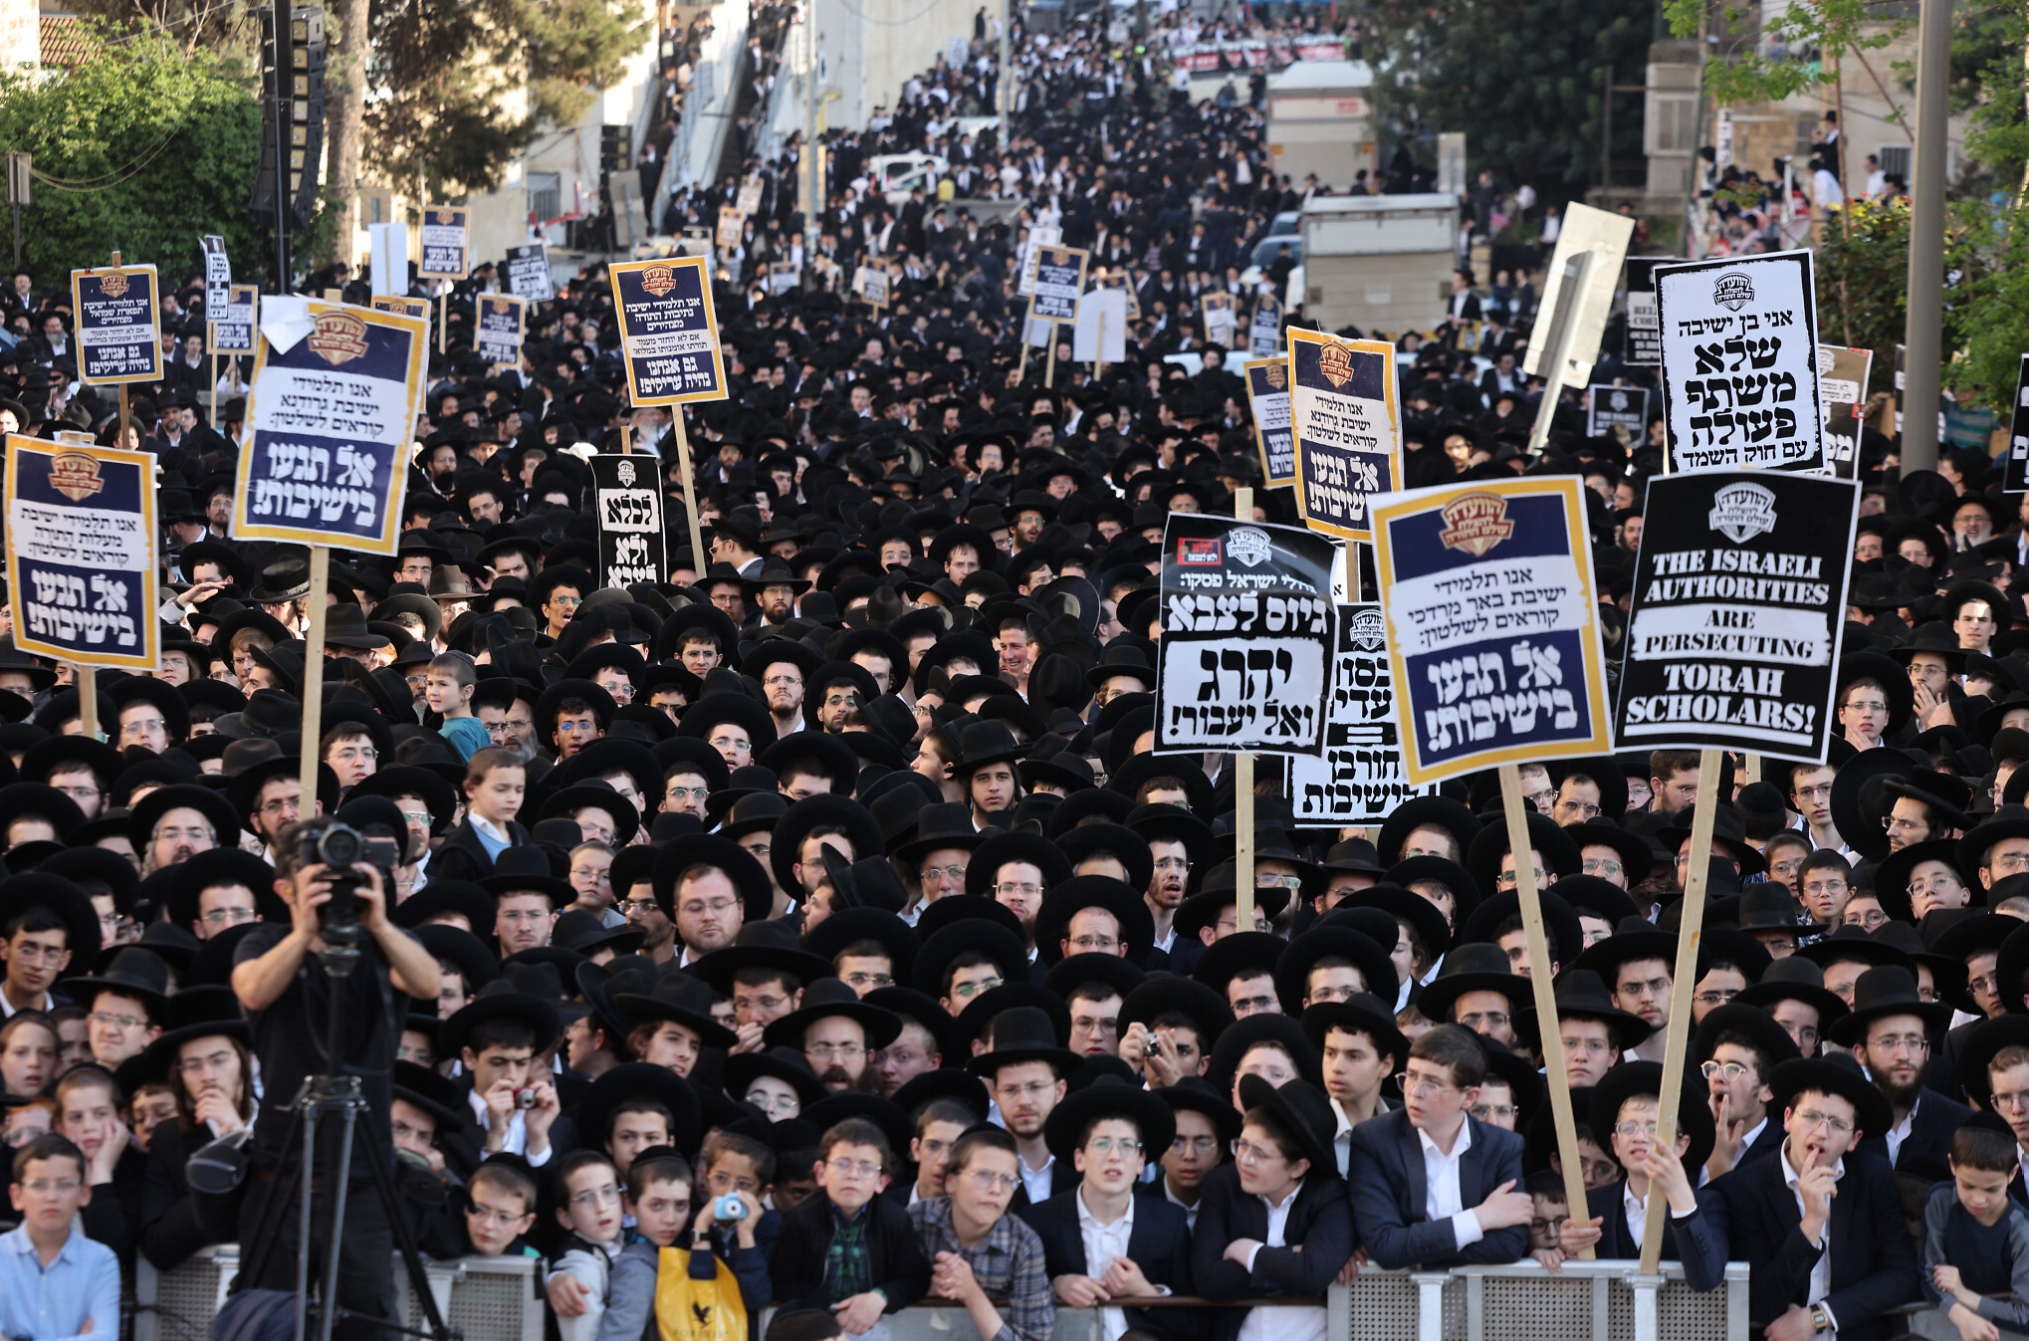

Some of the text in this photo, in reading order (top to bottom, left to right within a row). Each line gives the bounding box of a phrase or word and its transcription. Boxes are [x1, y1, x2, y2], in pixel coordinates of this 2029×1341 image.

[84, 298, 148, 310] אנו תלמידי ישיבת
[89, 307, 143, 317] תפארת שמואל
[626, 297, 700, 313] אנו תלמידי ישיבת
[635, 308, 694, 322] נתיבות התורה
[101, 316, 132, 325] מצהירים
[647, 320, 684, 331] מצהירים
[1678, 317, 1733, 337] ישיבה
[1739, 315, 1759, 336] בן
[1764, 310, 1792, 327] אני
[658, 335, 675, 344] יוחזר
[658, 344, 685, 352] אומנותו
[678, 333, 687, 341] לא
[90, 358, 150, 374] נהיה עריקים!
[98, 346, 140, 360] גם אנחנו
[647, 356, 698, 376] גם אנחנו
[1694, 335, 1781, 375] שלא
[293, 375, 372, 398] אנו תלמידי
[640, 372, 711, 394] נהיה עריקים!
[1685, 371, 1796, 414] משתף
[281, 394, 380, 416] ישיבת גרודנא
[1315, 395, 1363, 416] אנו תלמידי
[271, 412, 384, 440] קוראים לשלטון:
[1311, 410, 1338, 427] גרודנא
[1341, 416, 1370, 431] ישיבת
[1690, 407, 1797, 447] פעולה
[1307, 424, 1378, 450] קוראים לשלטון:
[268, 442, 376, 489] אל תגעו
[1683, 441, 1808, 468] עם חוק השמד
[1310, 450, 1347, 487] תגעו
[1350, 456, 1380, 492] אל
[252, 479, 376, 528] בישיבות!
[607, 494, 652, 526] לכלא
[1308, 480, 1368, 521] שיבות!
[1446, 498, 1502, 522] הוועדה
[1721, 490, 1768, 506] הוועדה
[20, 507, 136, 532] אנו תלמידי ישיבת
[35, 526, 122, 547] מעלות התורה
[616, 533, 648, 565] ולא
[28, 542, 129, 568] קוראים לשלטון:
[1653, 549, 1822, 579] THE ISRAELI
[31, 569, 128, 612] אל תגעו
[1180, 572, 1222, 591] פסקו:
[1226, 569, 1277, 588] ישראל
[1434, 566, 1532, 594] אנו תלמידי
[1644, 575, 1829, 606] AUTHORITIES
[1168, 590, 1327, 634] גיוס לצבא
[1408, 587, 1566, 625] ישיבת באר מרדכי
[27, 601, 137, 646] בישיבות!
[1420, 609, 1559, 648] קוראים לשלטון:
[1705, 610, 1756, 629] ARE
[1644, 633, 1813, 659] PERSECUTING
[1197, 647, 1292, 701] יהרג
[1427, 639, 1563, 705] אל תגעו
[1664, 664, 1784, 697] TORAH
[1170, 699, 1313, 738] ואל יעבור!
[1424, 688, 1578, 752] בישיבות!
[1626, 694, 1816, 734] SCHOLARS!
[1328, 750, 1400, 783] חורבן
